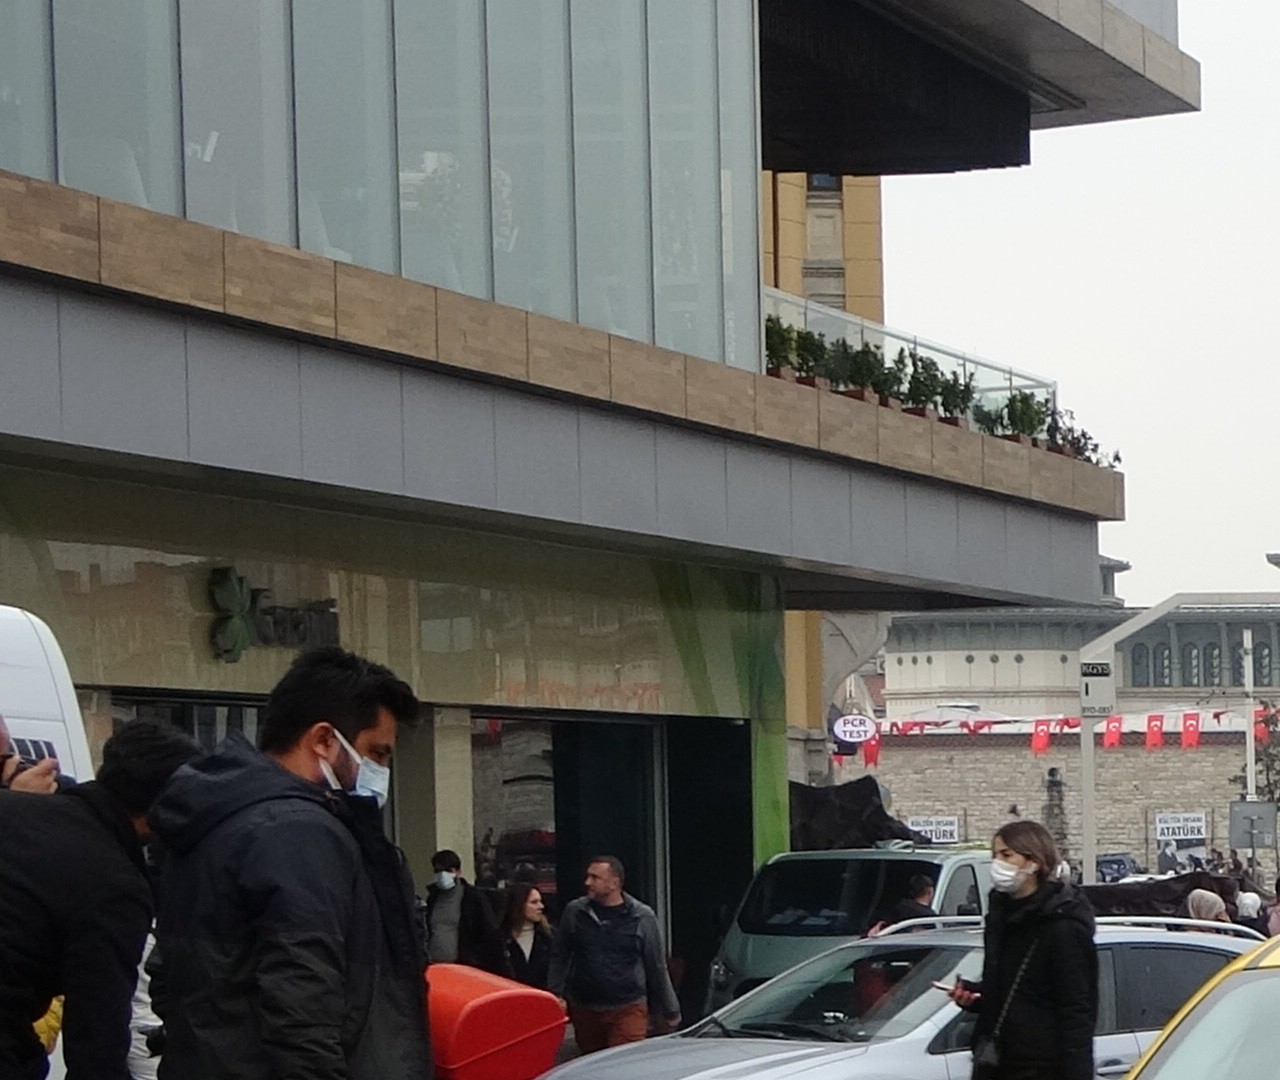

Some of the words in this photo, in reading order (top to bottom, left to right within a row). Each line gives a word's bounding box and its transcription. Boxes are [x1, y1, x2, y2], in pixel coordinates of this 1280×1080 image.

[843, 718, 866, 727] PCR
[842, 730, 869, 738] TEST
[1160, 824, 1203, 837] ATATÜRK
